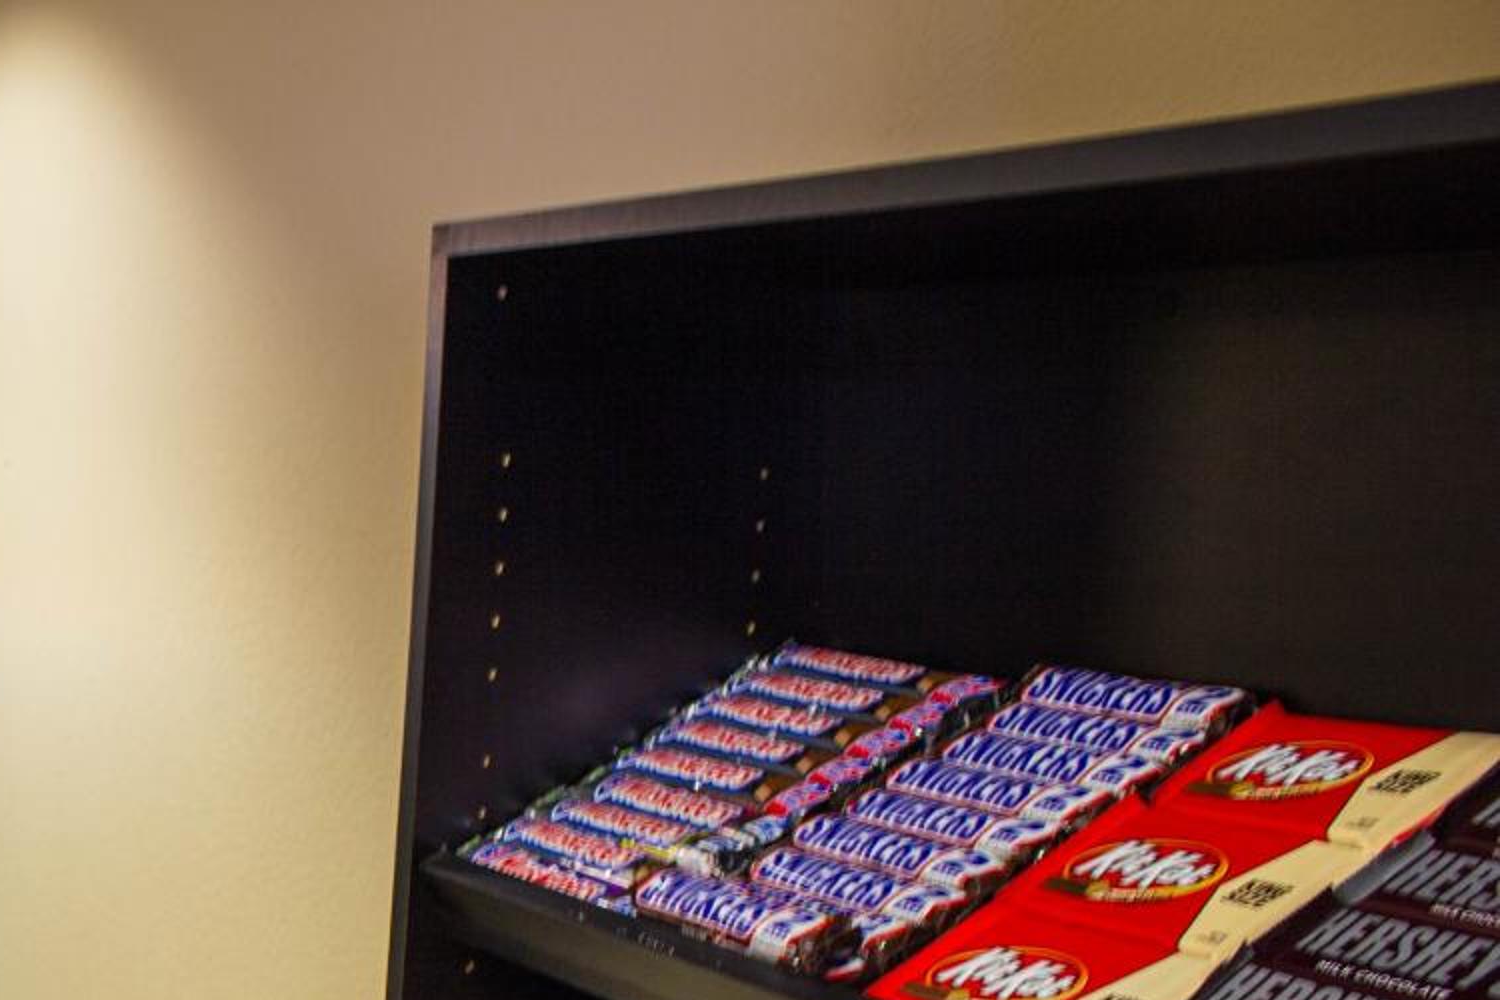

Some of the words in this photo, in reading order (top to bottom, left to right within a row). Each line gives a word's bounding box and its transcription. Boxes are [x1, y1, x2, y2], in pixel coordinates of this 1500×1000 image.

[993, 702, 1142, 752] SNICKERS
[892, 758, 1037, 810] SNICKERS
[946, 731, 1093, 785] SNICKERS
[799, 815, 940, 873] SNICKERS
[1296, 906, 1500, 1000] HERSHEY
[1316, 958, 1353, 977] MILK
